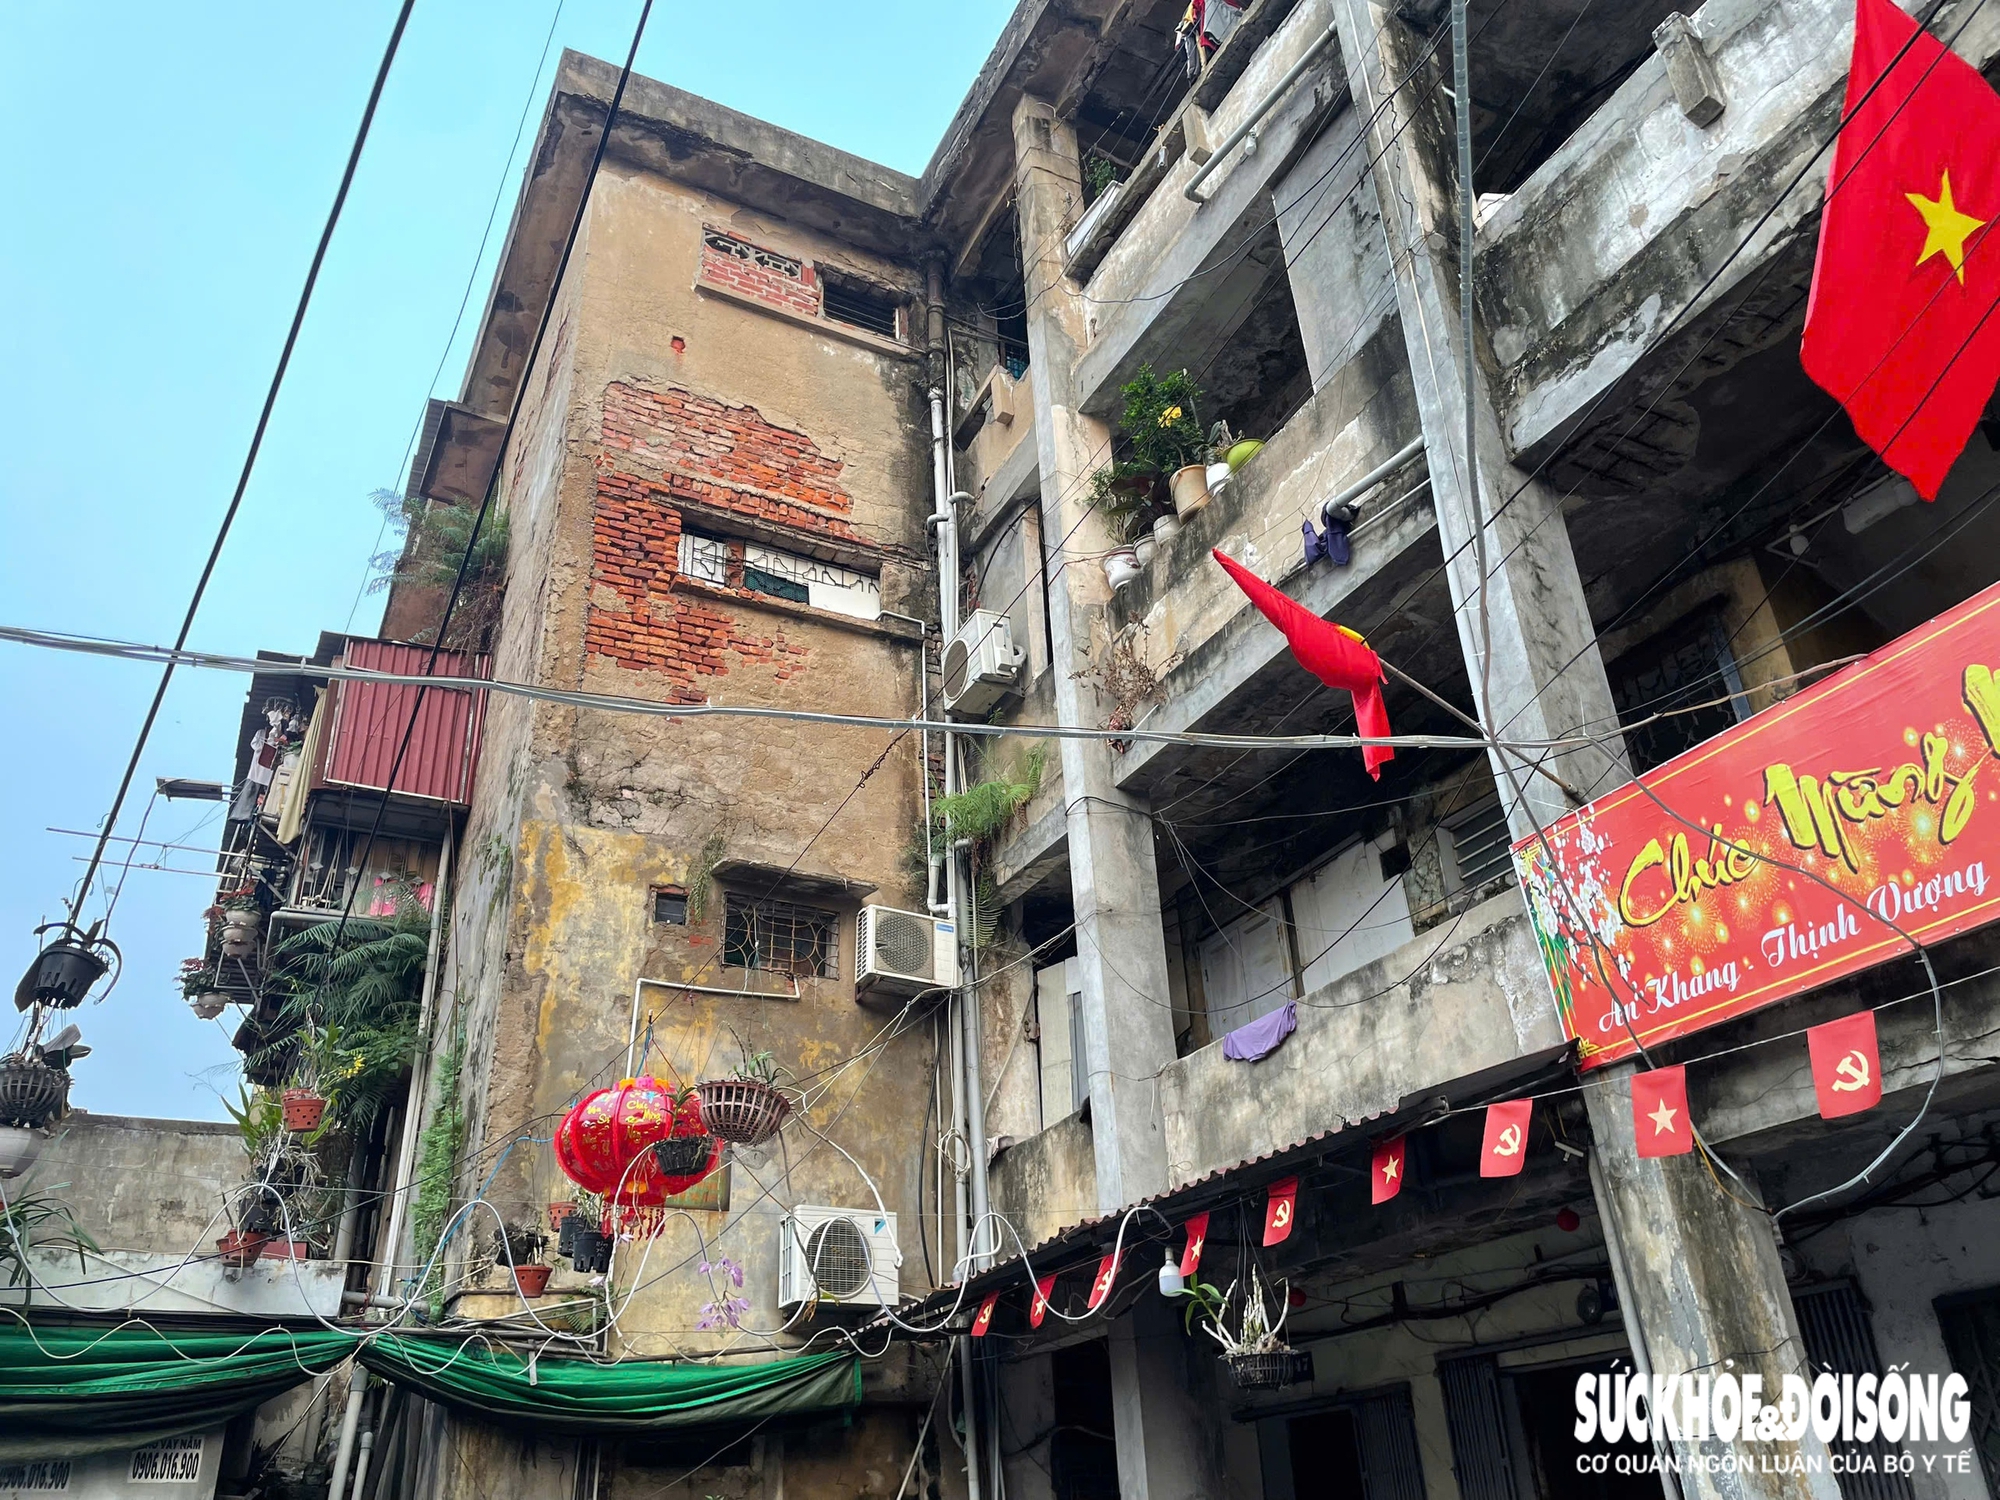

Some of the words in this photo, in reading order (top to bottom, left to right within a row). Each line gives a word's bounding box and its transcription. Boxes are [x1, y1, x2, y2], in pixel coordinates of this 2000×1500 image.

[1619, 824, 1762, 927] Chúc
[1599, 998, 1640, 1032] An
[1646, 961, 1741, 1014] Khang
[1761, 903, 1861, 968] Thịnh
[1866, 861, 1990, 922] Vượng
[132, 1451, 200, 1480] 0906.016.900
